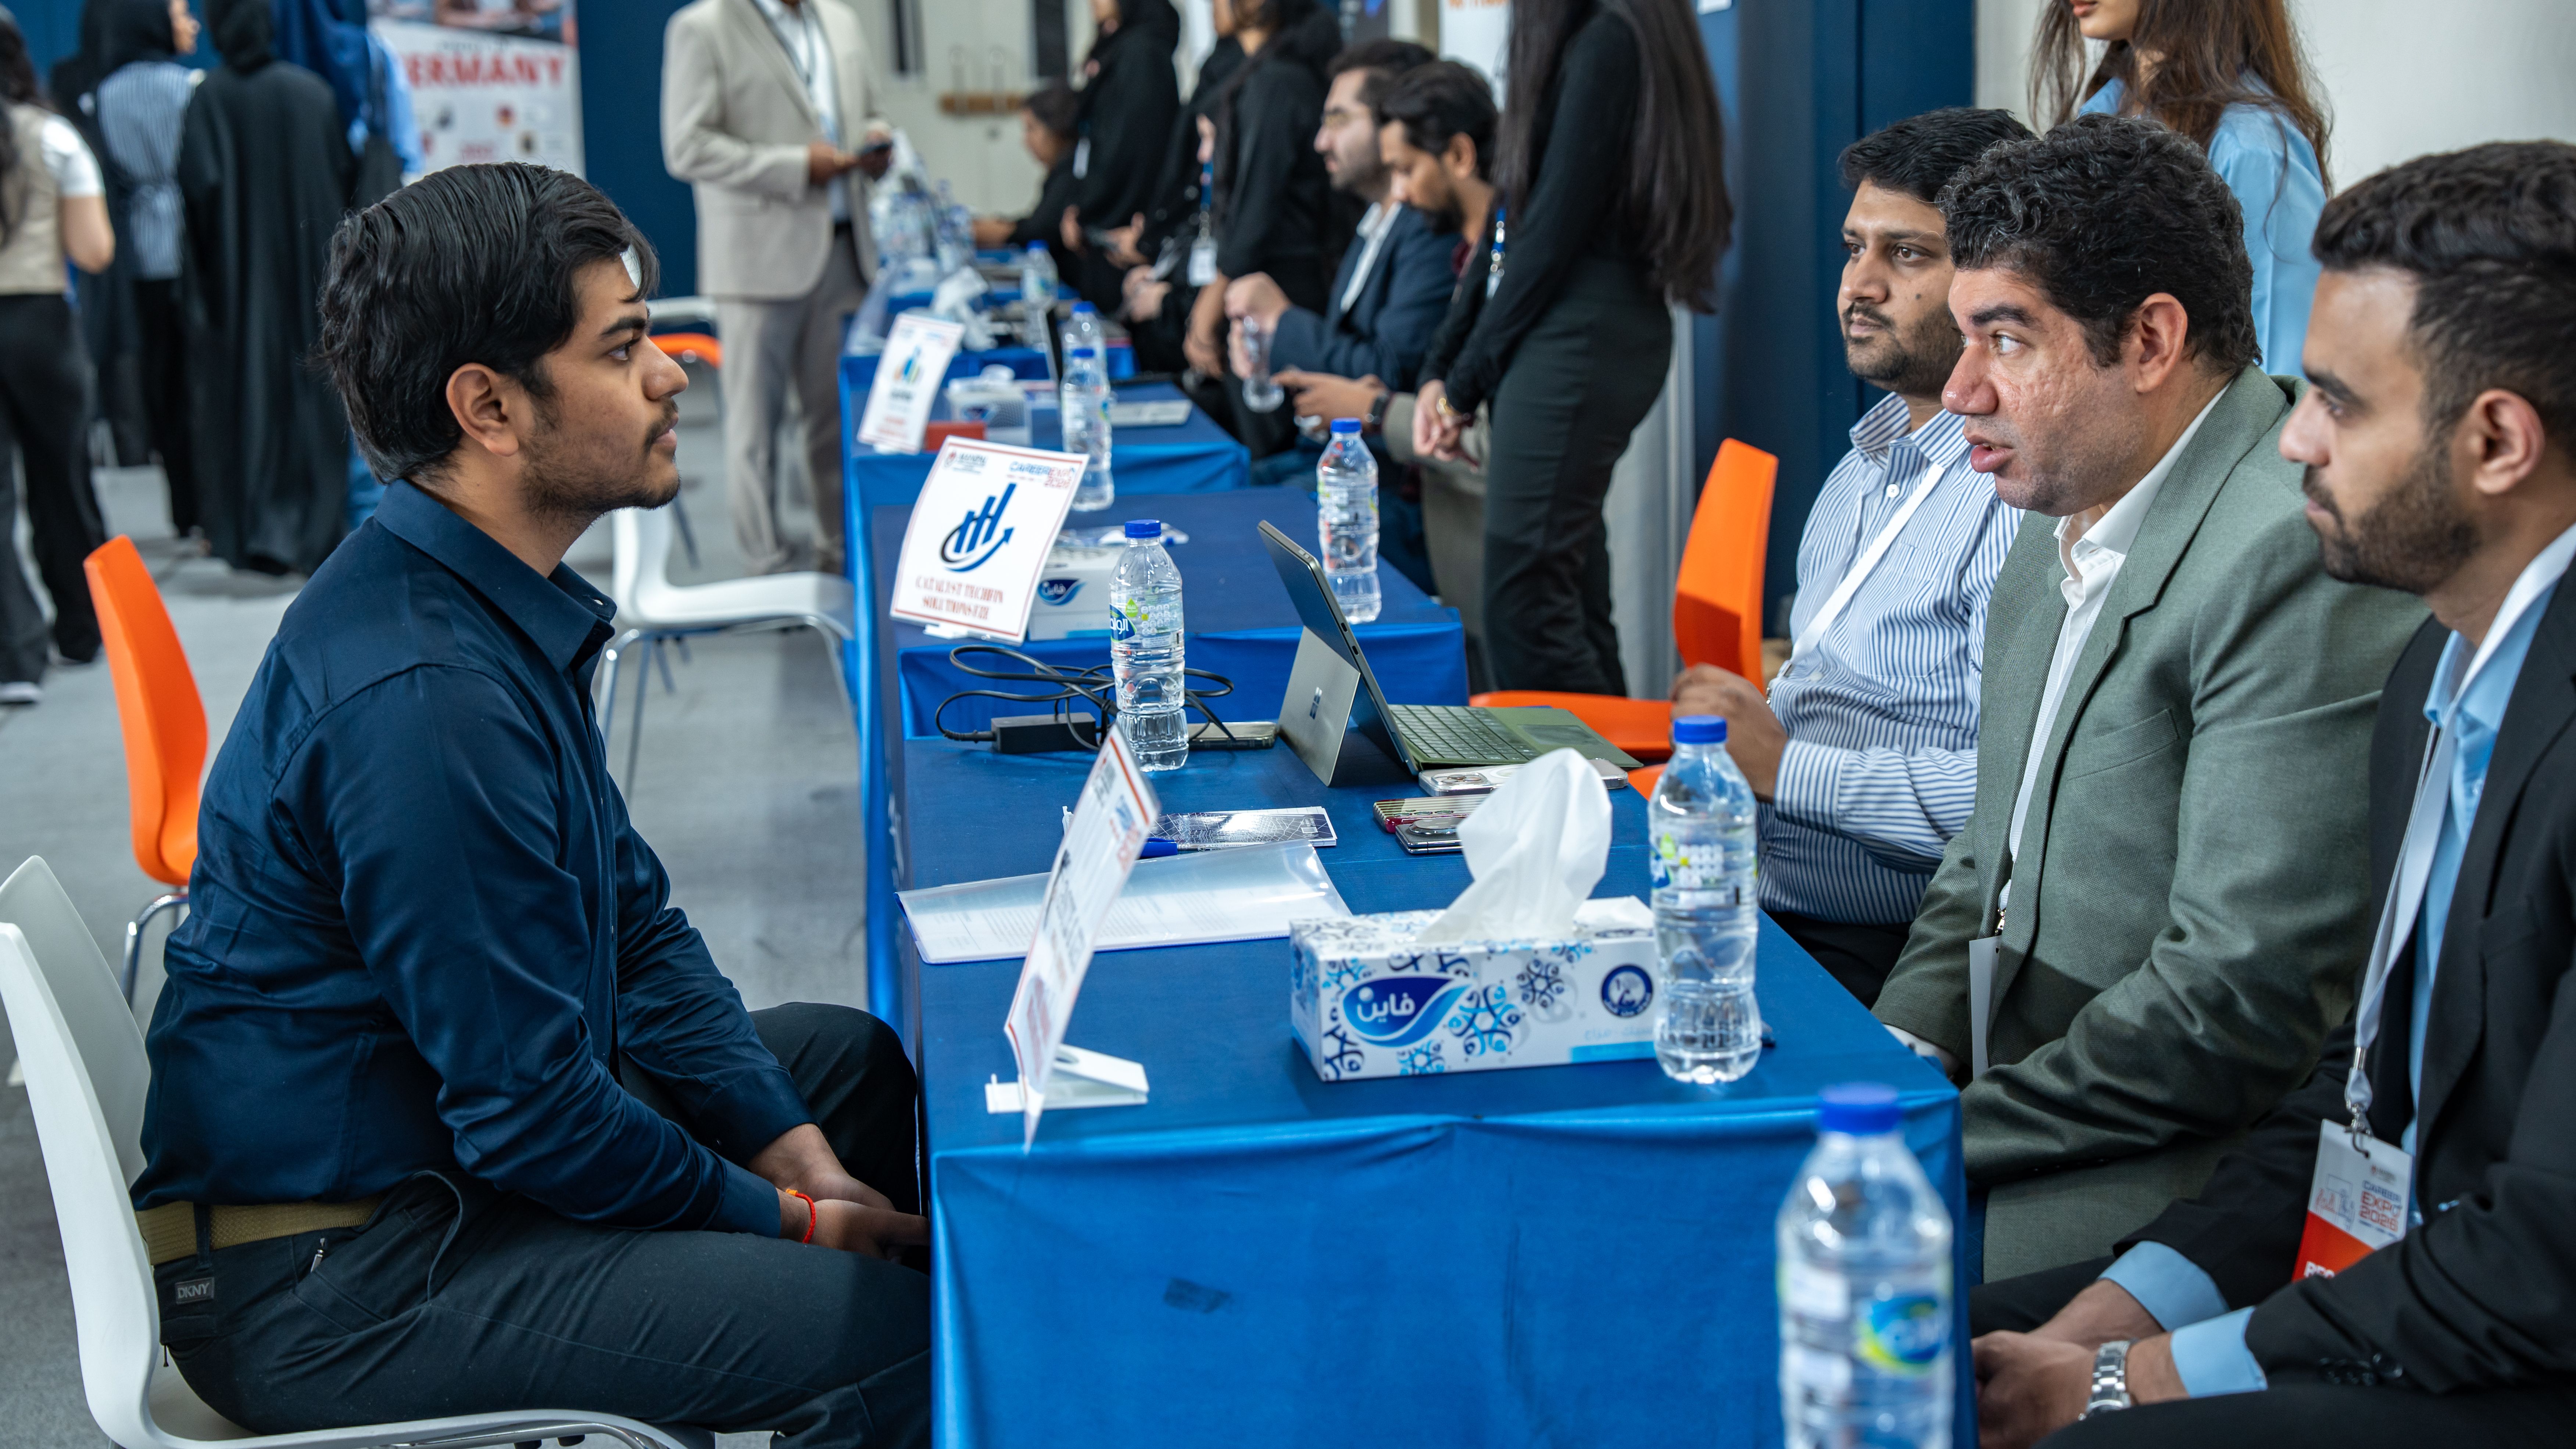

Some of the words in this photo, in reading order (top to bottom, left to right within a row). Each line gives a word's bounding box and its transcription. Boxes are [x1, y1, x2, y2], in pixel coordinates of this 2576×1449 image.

[402, 51, 564, 88] ERMANY
[1009, 461, 1051, 475] CAREER
[1041, 581, 1066, 596] فاين
[1356, 986, 1416, 1022] فاين
[2363, 1180, 2402, 1203] CAREER
[2361, 1191, 2402, 1218] EXPO
[2359, 1205, 2398, 1232] 2026
[178, 1282, 210, 1298] DKNY
